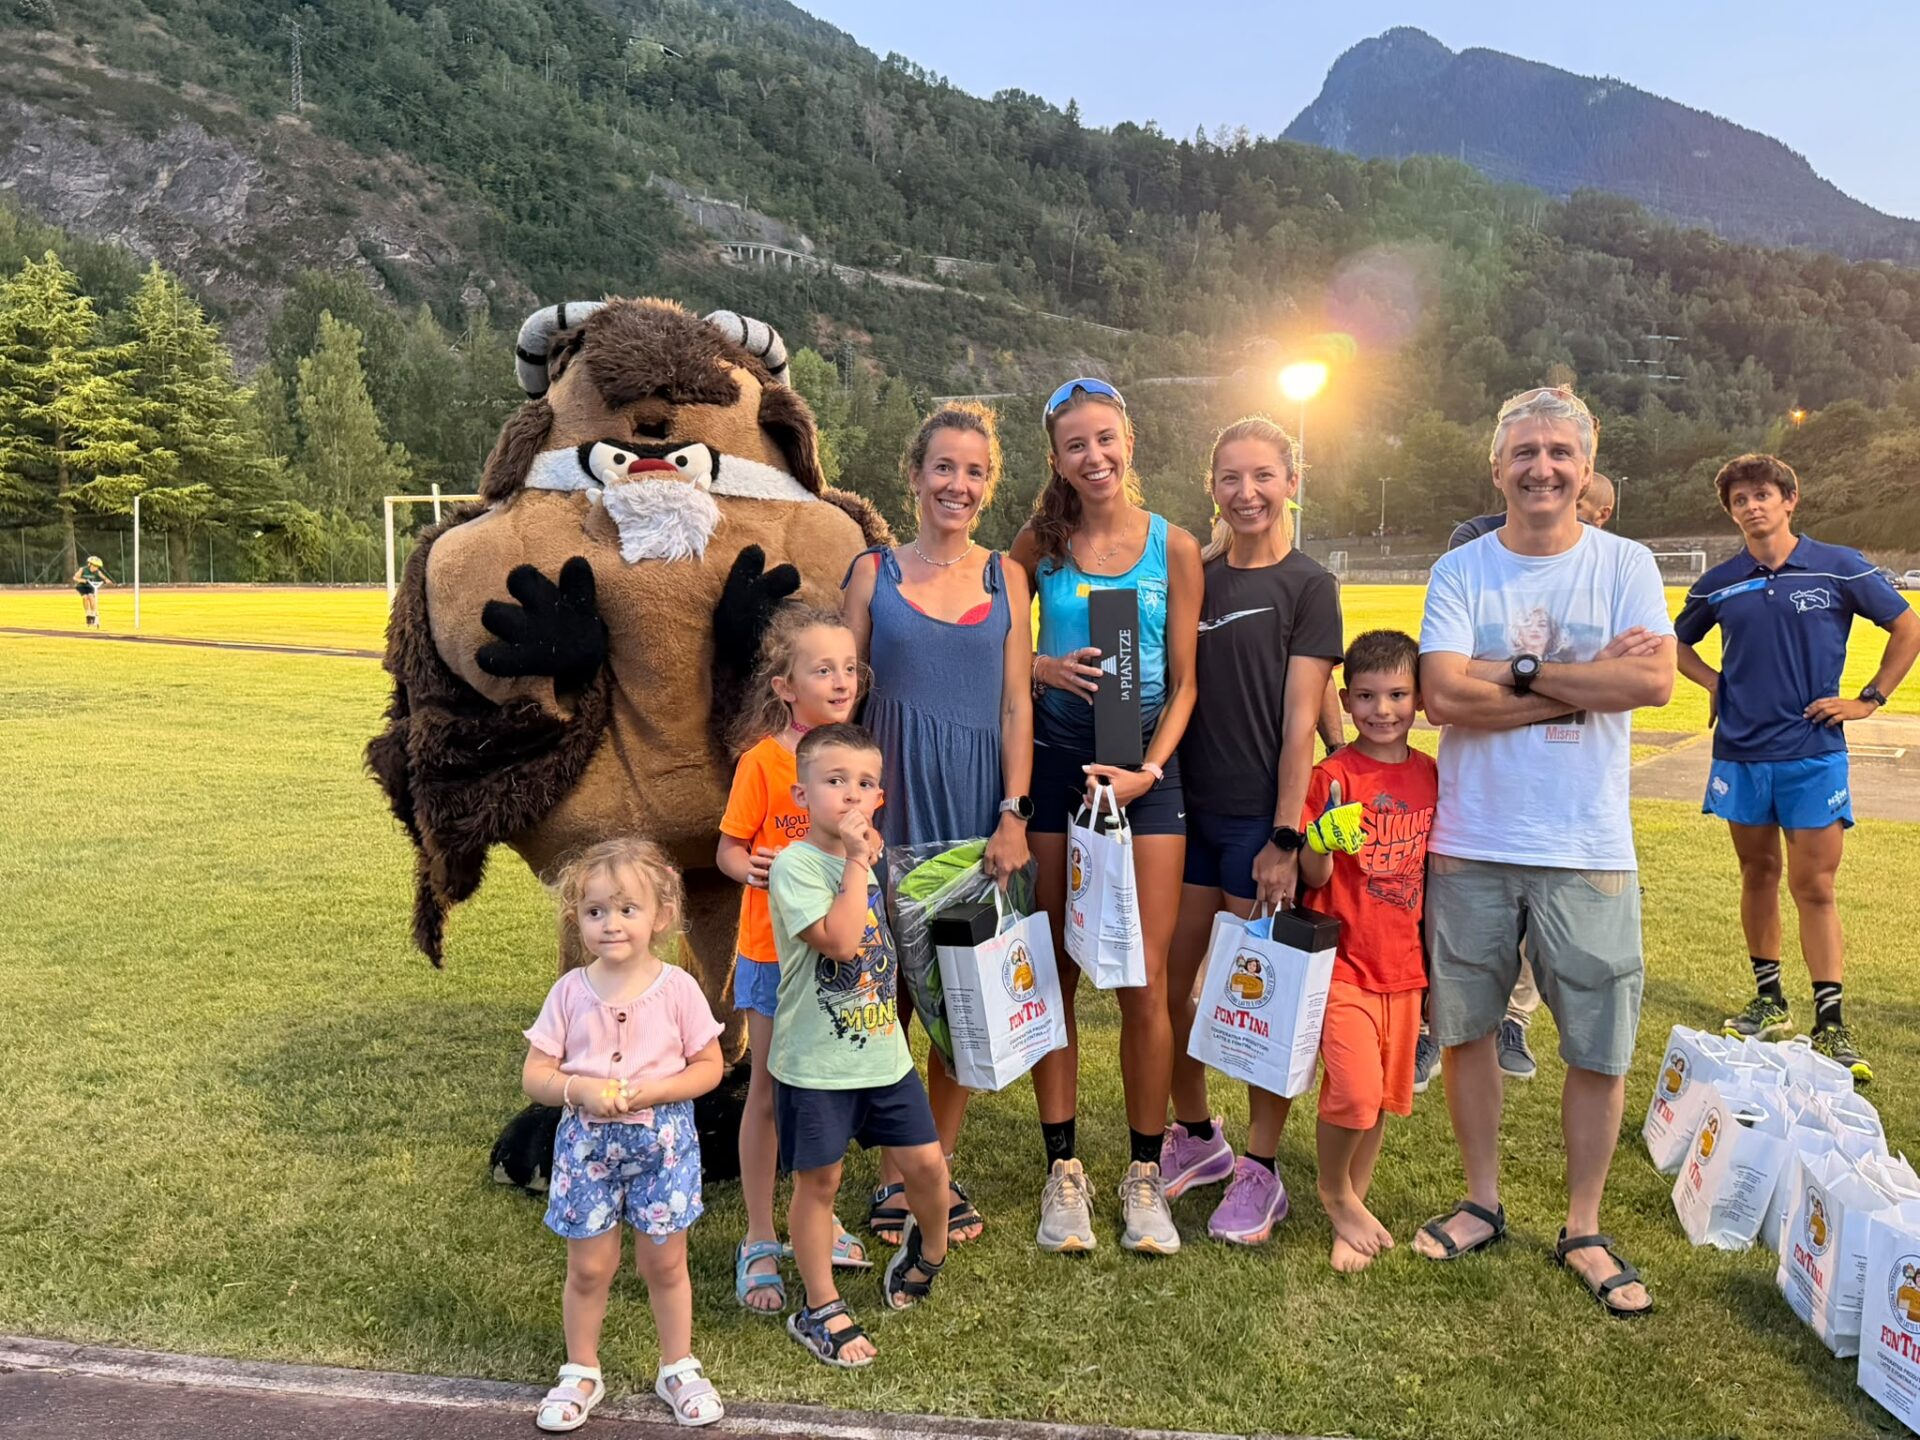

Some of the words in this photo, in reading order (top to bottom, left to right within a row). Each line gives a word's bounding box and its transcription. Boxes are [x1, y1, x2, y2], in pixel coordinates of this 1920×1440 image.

[775, 814, 810, 829] Mou
[1360, 806, 1434, 845] SUMME
[840, 996, 897, 1032] MON
[1214, 1004, 1269, 1038] FONTINA
